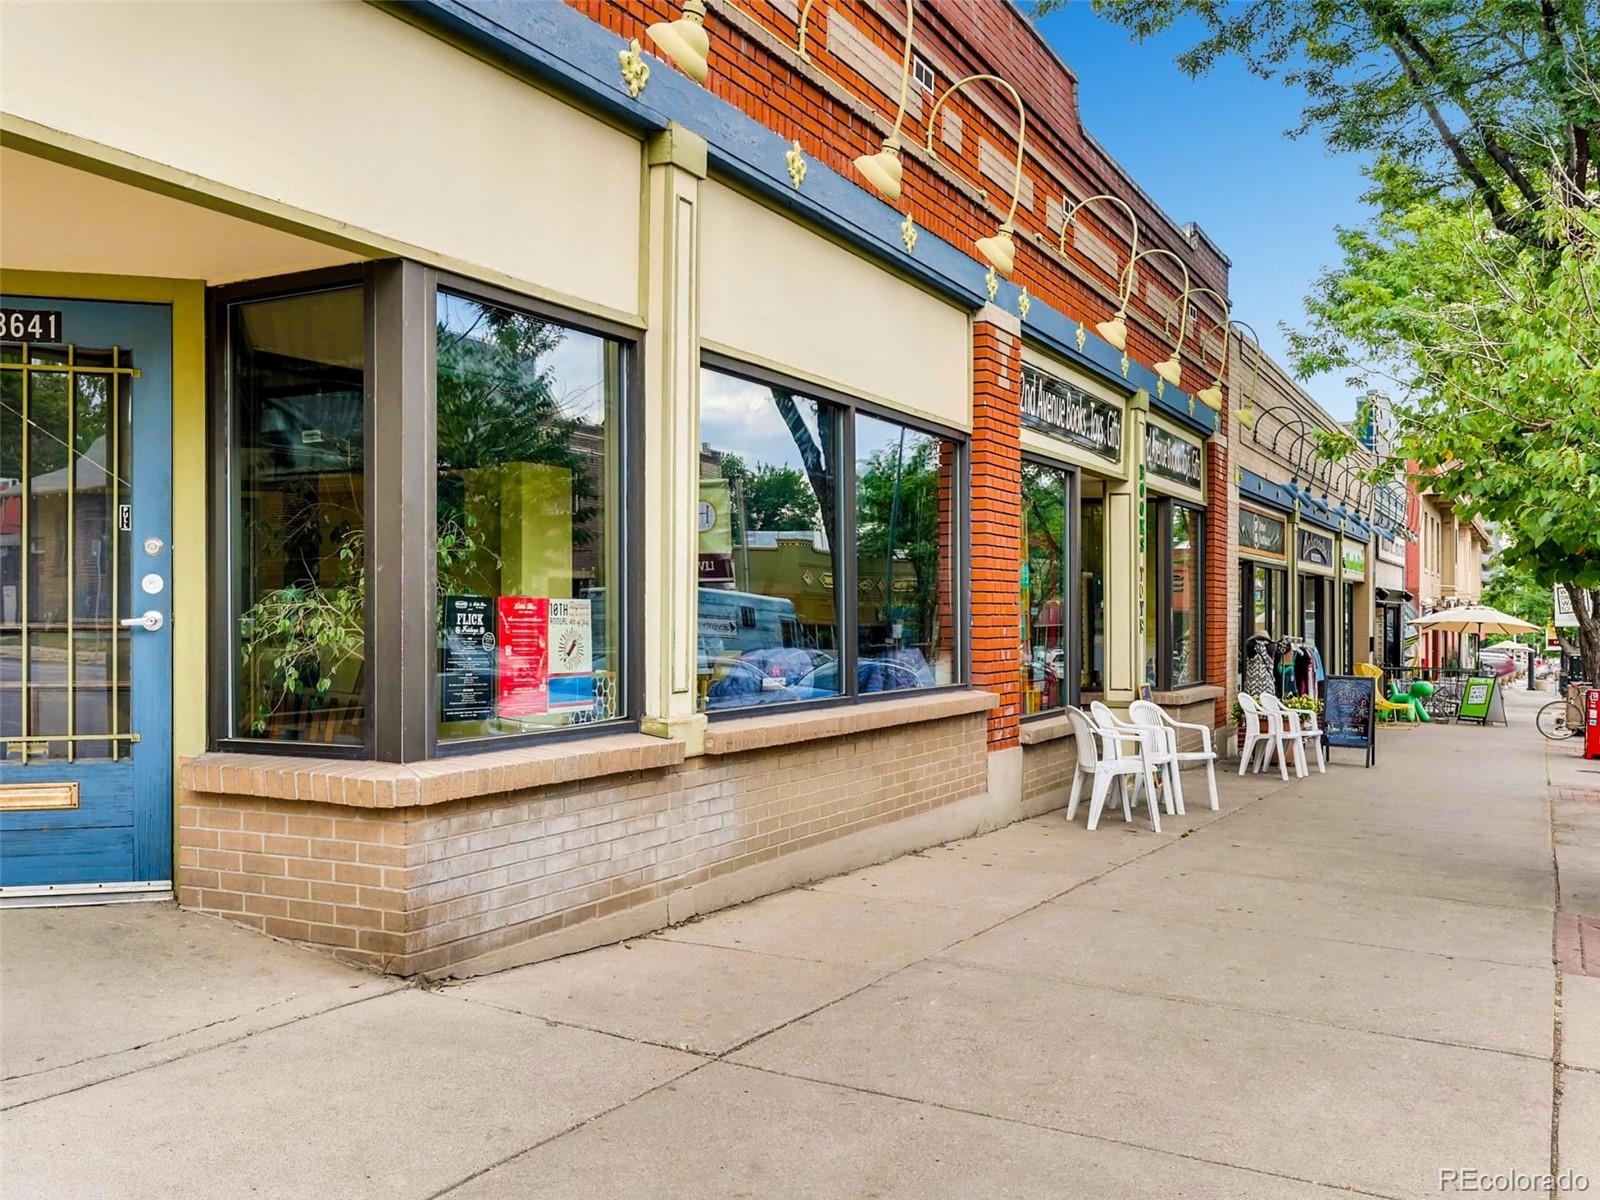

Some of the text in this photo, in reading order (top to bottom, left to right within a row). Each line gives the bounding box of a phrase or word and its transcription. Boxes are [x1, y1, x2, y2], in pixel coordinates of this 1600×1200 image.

[1037, 378, 1066, 428] Avenue
[1107, 410, 1121, 449] Gifts
[122, 506, 130, 530] PULL
[456, 613, 484, 625] FLICK
[550, 602, 569, 617] 10TH
